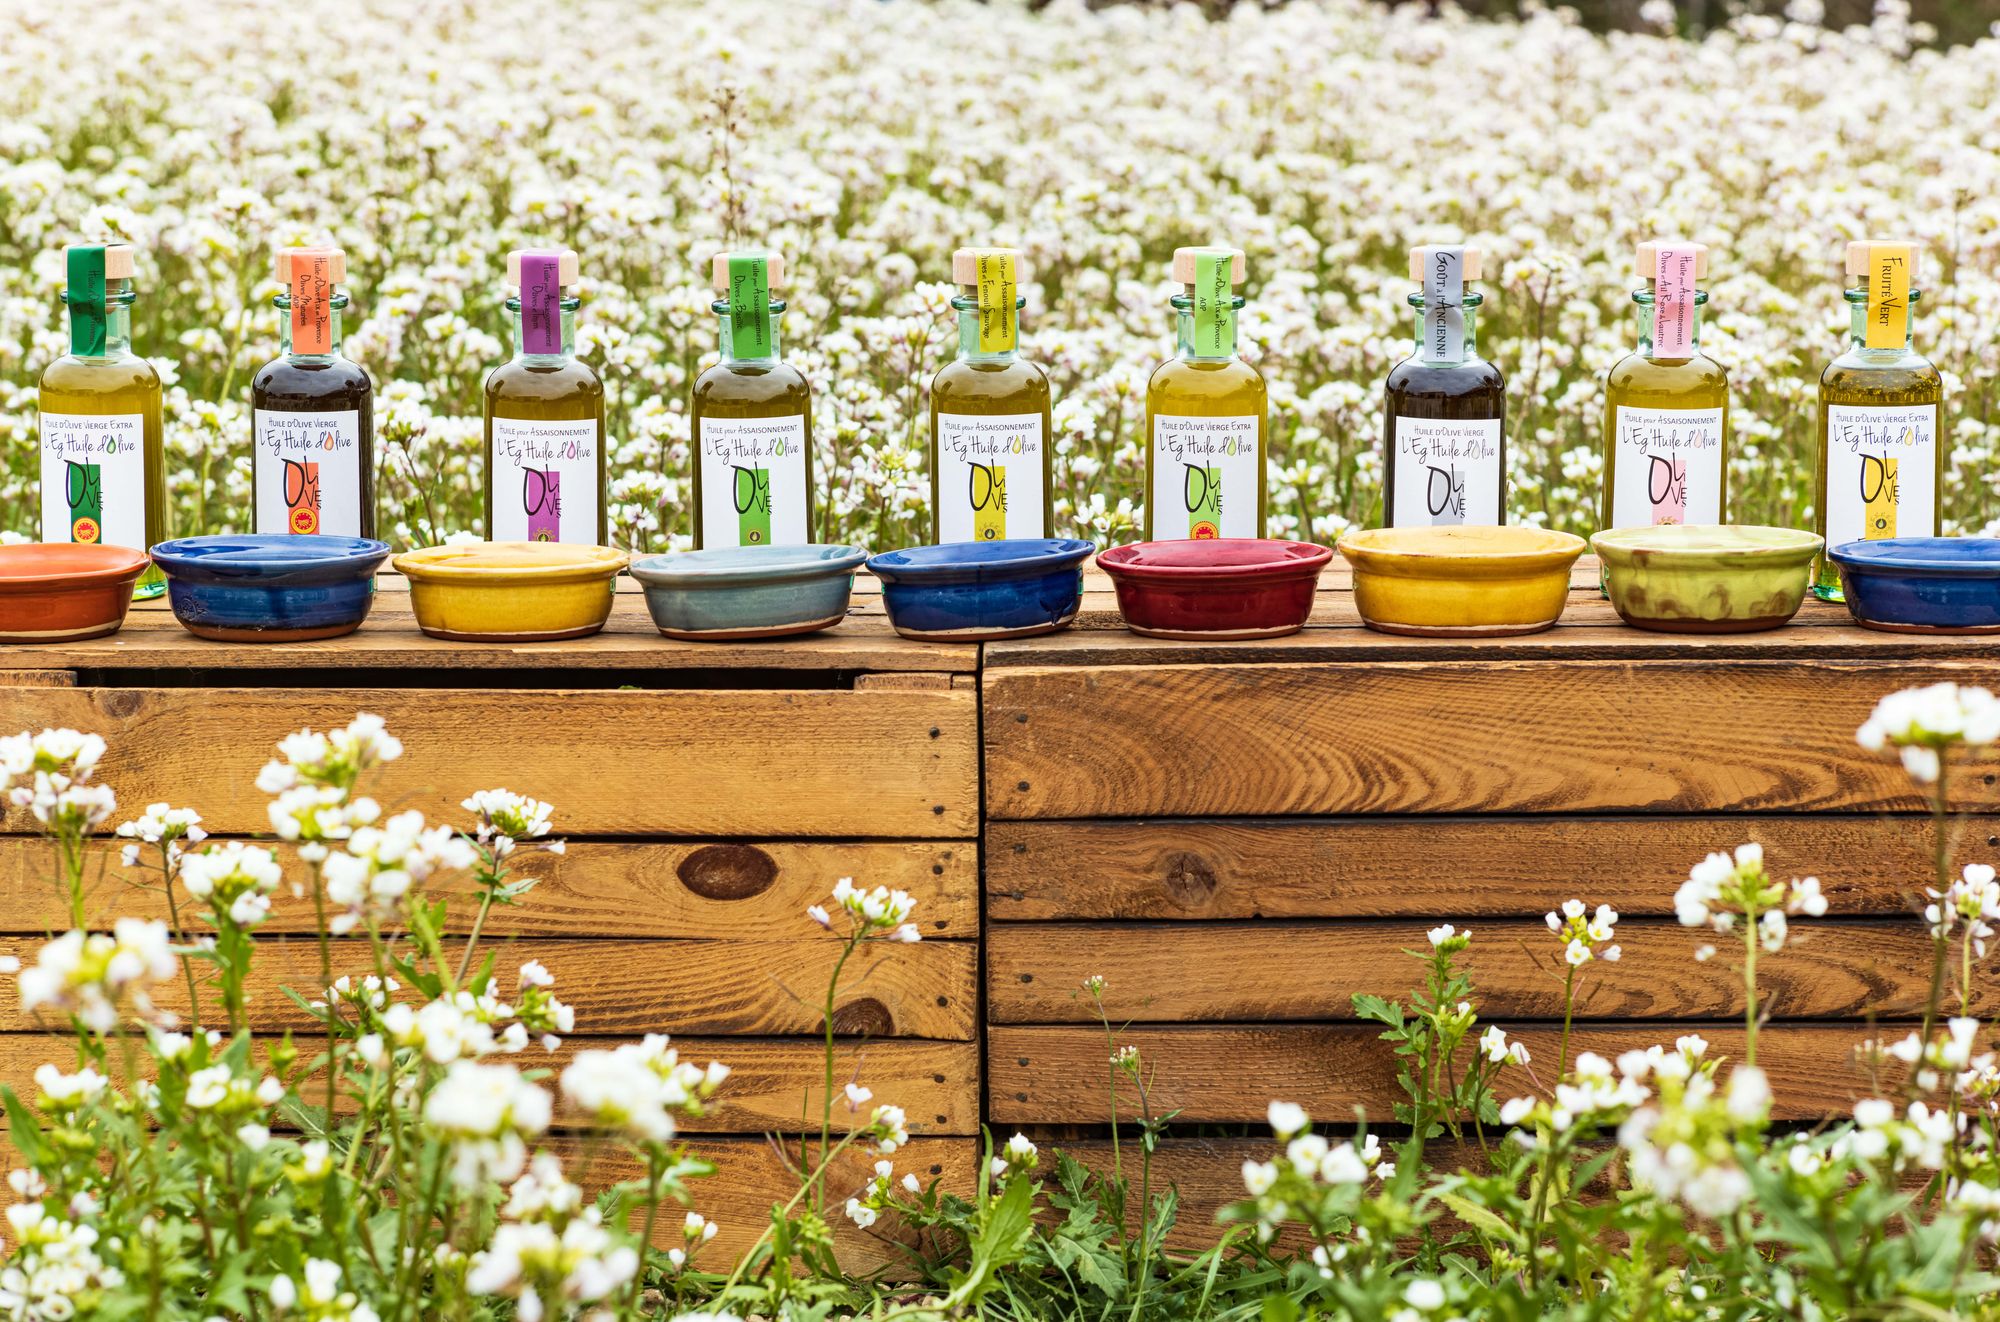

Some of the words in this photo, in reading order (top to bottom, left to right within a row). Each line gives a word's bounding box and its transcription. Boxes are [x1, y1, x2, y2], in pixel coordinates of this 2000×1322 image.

[314, 257, 326, 275] Huile
[752, 258, 764, 277] Huile
[1216, 257, 1228, 276] Huile
[1661, 251, 1672, 273] Olives
[1680, 256, 1692, 276] Huile
[544, 263, 556, 282] Huile
[300, 274, 311, 294] Olives
[735, 275, 745, 297] Olives
[983, 280, 994, 306] Fenouil
[1660, 279, 1672, 291] Ail
[314, 298, 326, 310] Aix
[532, 286, 543, 307] Olives
[1660, 294, 1672, 314] Rose
[736, 304, 746, 328] Basilic
[753, 288, 764, 346] Assaisonnement
[1001, 281, 1013, 338] Assaisonnement
[1216, 300, 1227, 314] Aix
[1677, 288, 1691, 345] Assaisonnement
[316, 316, 327, 344] Provence
[983, 307, 995, 338] Sauvage
[1215, 319, 1227, 349] Provence
[1658, 320, 1671, 347] Lautrec
[738, 425, 797, 434] ASSAISONNEMENT
[976, 422, 1035, 431] ASSAISONNEMENT
[1658, 416, 1716, 424] ASSAISONNEMENT
[531, 428, 589, 436] ASSAISONNEMENT
